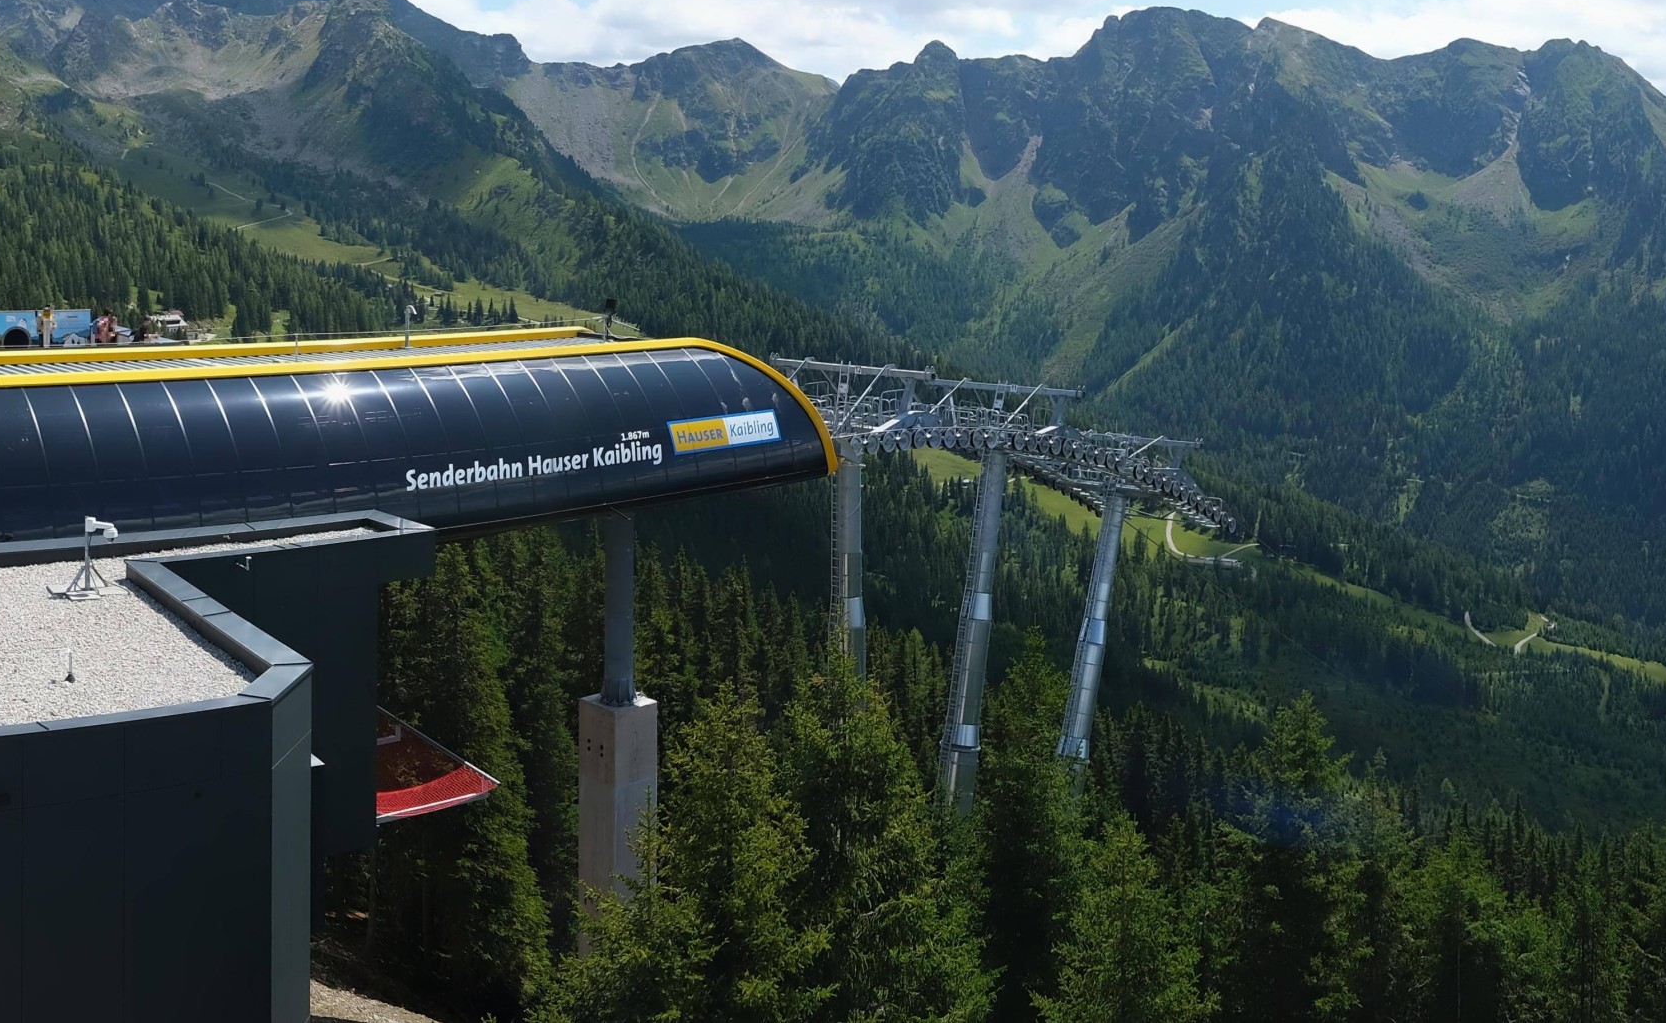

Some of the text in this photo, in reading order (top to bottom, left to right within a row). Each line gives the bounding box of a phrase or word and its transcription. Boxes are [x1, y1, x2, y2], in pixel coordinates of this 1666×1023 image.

[621, 430, 650, 441] 1.867m
[676, 420, 774, 444] HAUSER Kaibling
[406, 440, 662, 491] Senderbahn Hauser Kaibling
